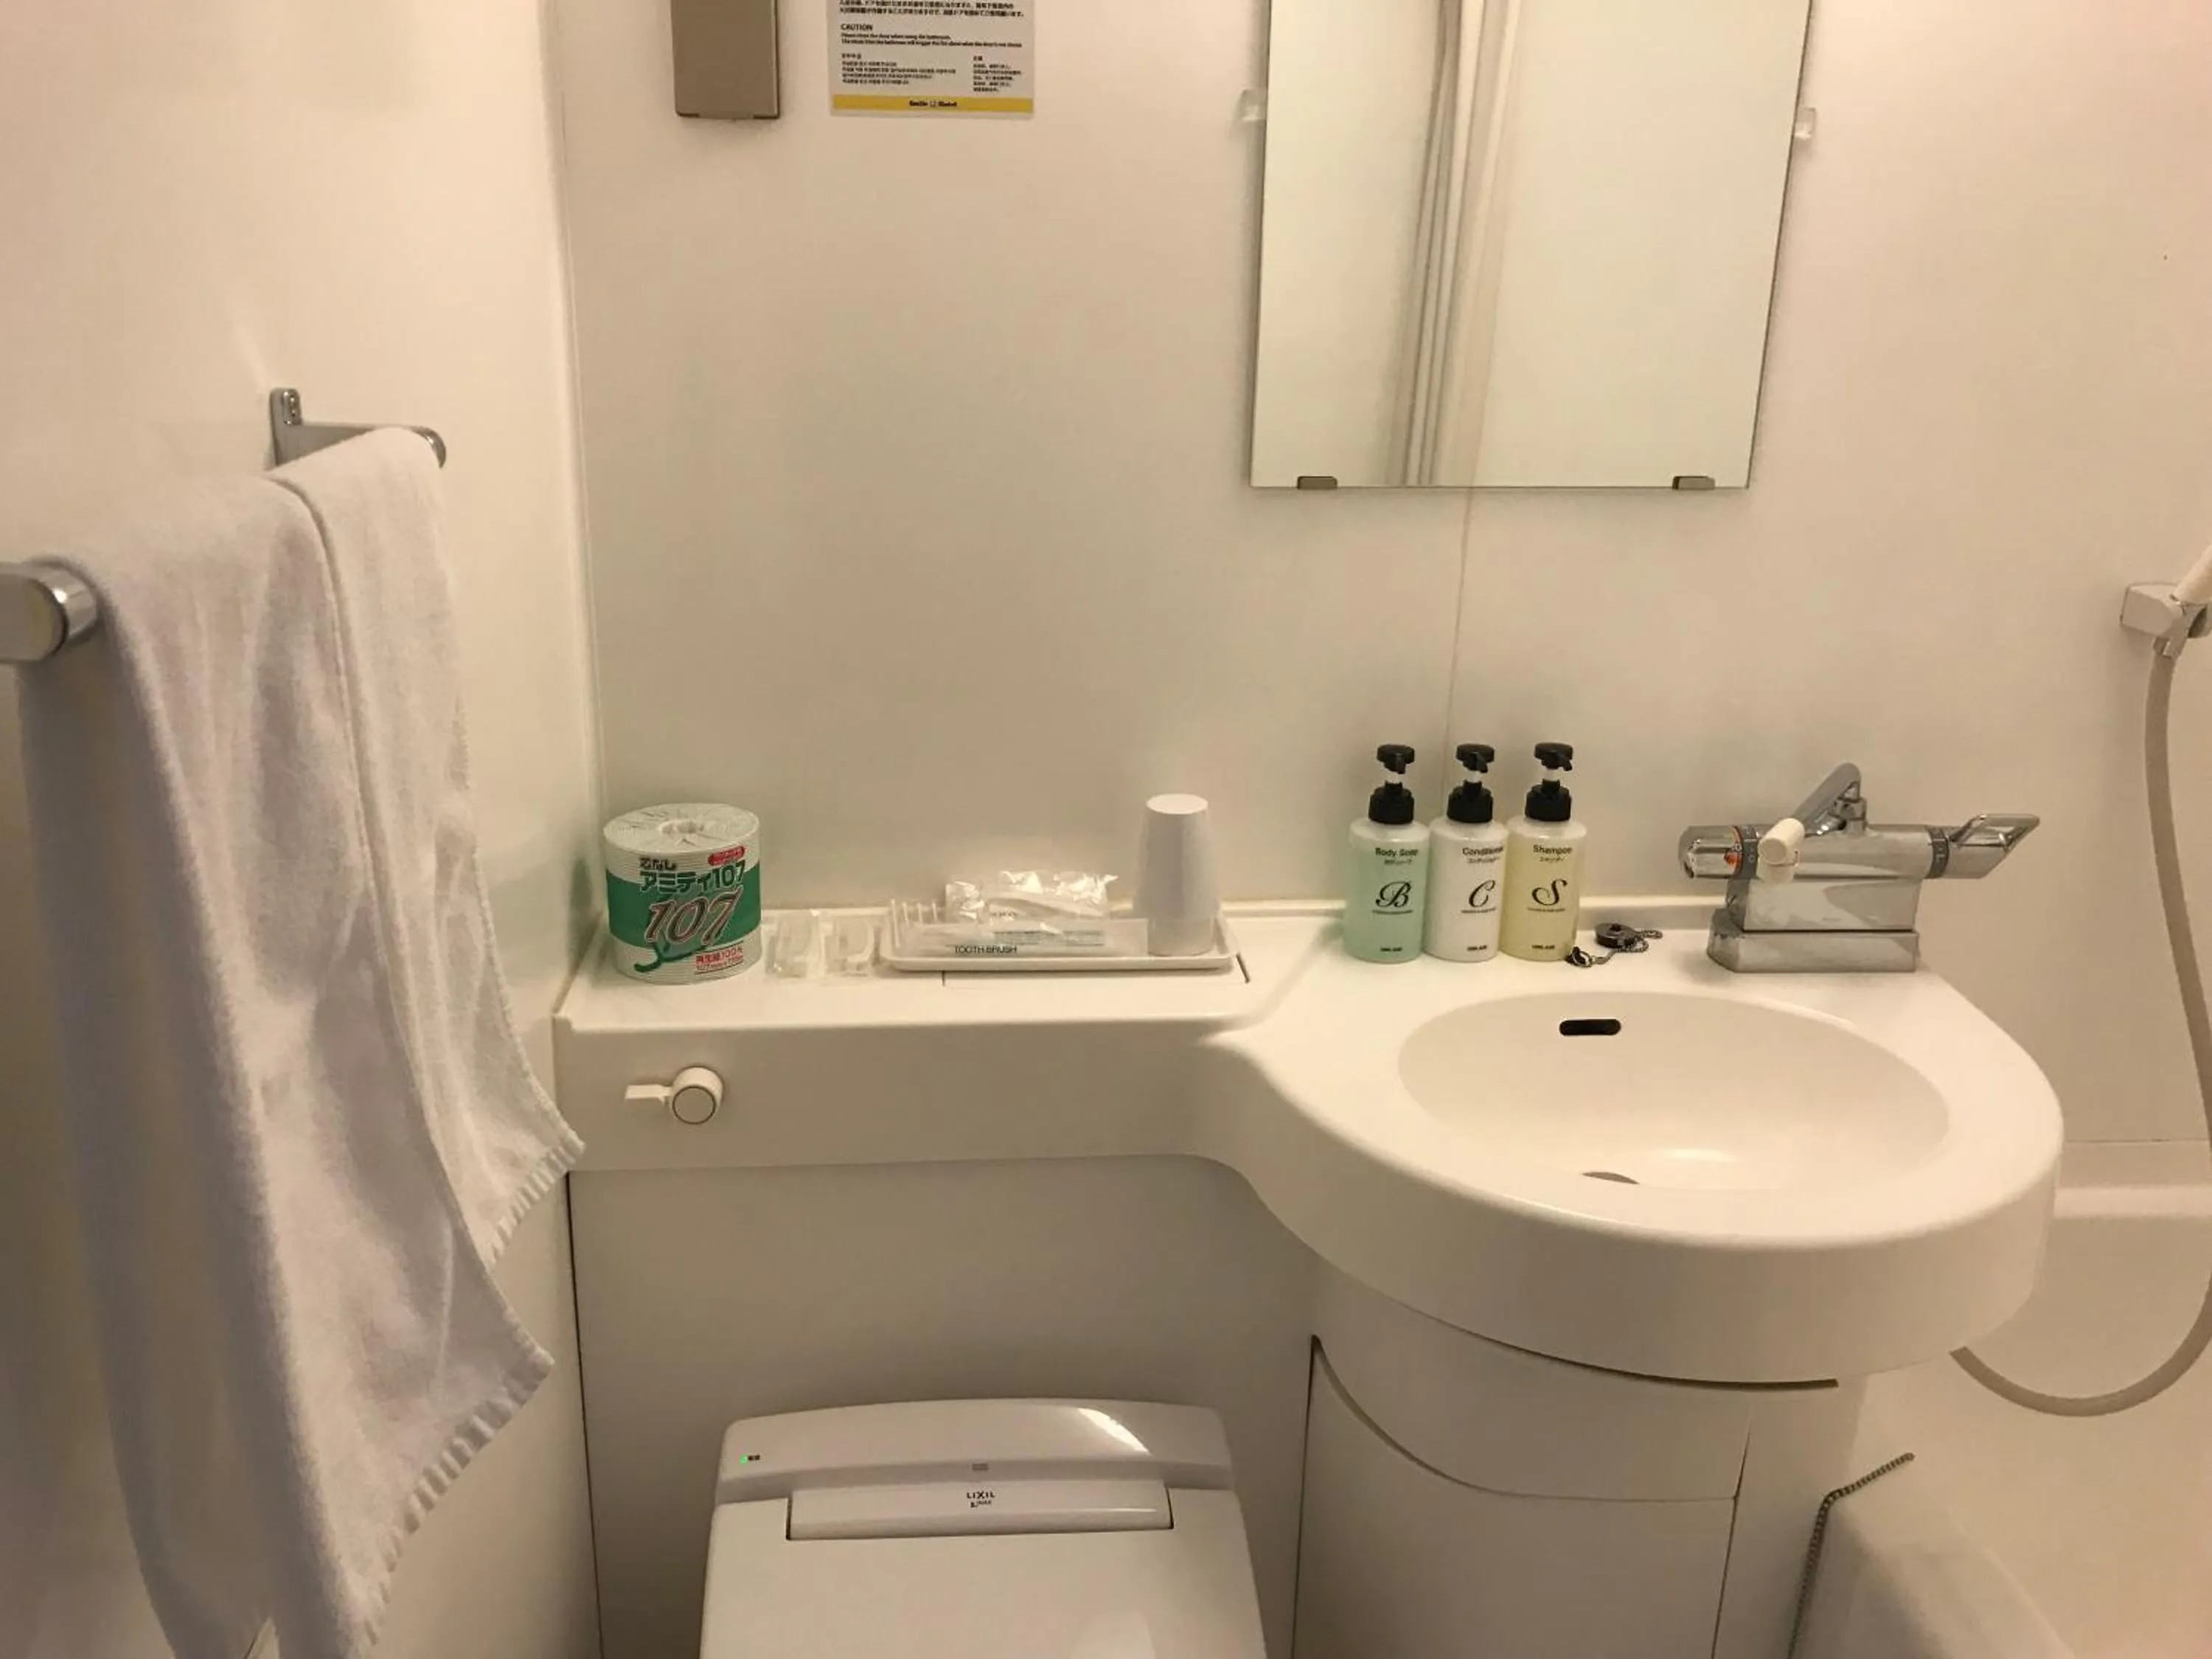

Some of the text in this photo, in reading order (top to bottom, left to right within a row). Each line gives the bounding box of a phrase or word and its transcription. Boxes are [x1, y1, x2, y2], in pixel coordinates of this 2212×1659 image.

[1375, 847, 1397, 857] Body
[1375, 880, 1412, 908] B
[1469, 880, 1496, 908] C
[1531, 878, 1568, 906] S
[644, 885, 743, 945] 107
[955, 945, 1017, 953] TOOTH BRUSH
[967, 1491, 996, 1499] LIXIL
